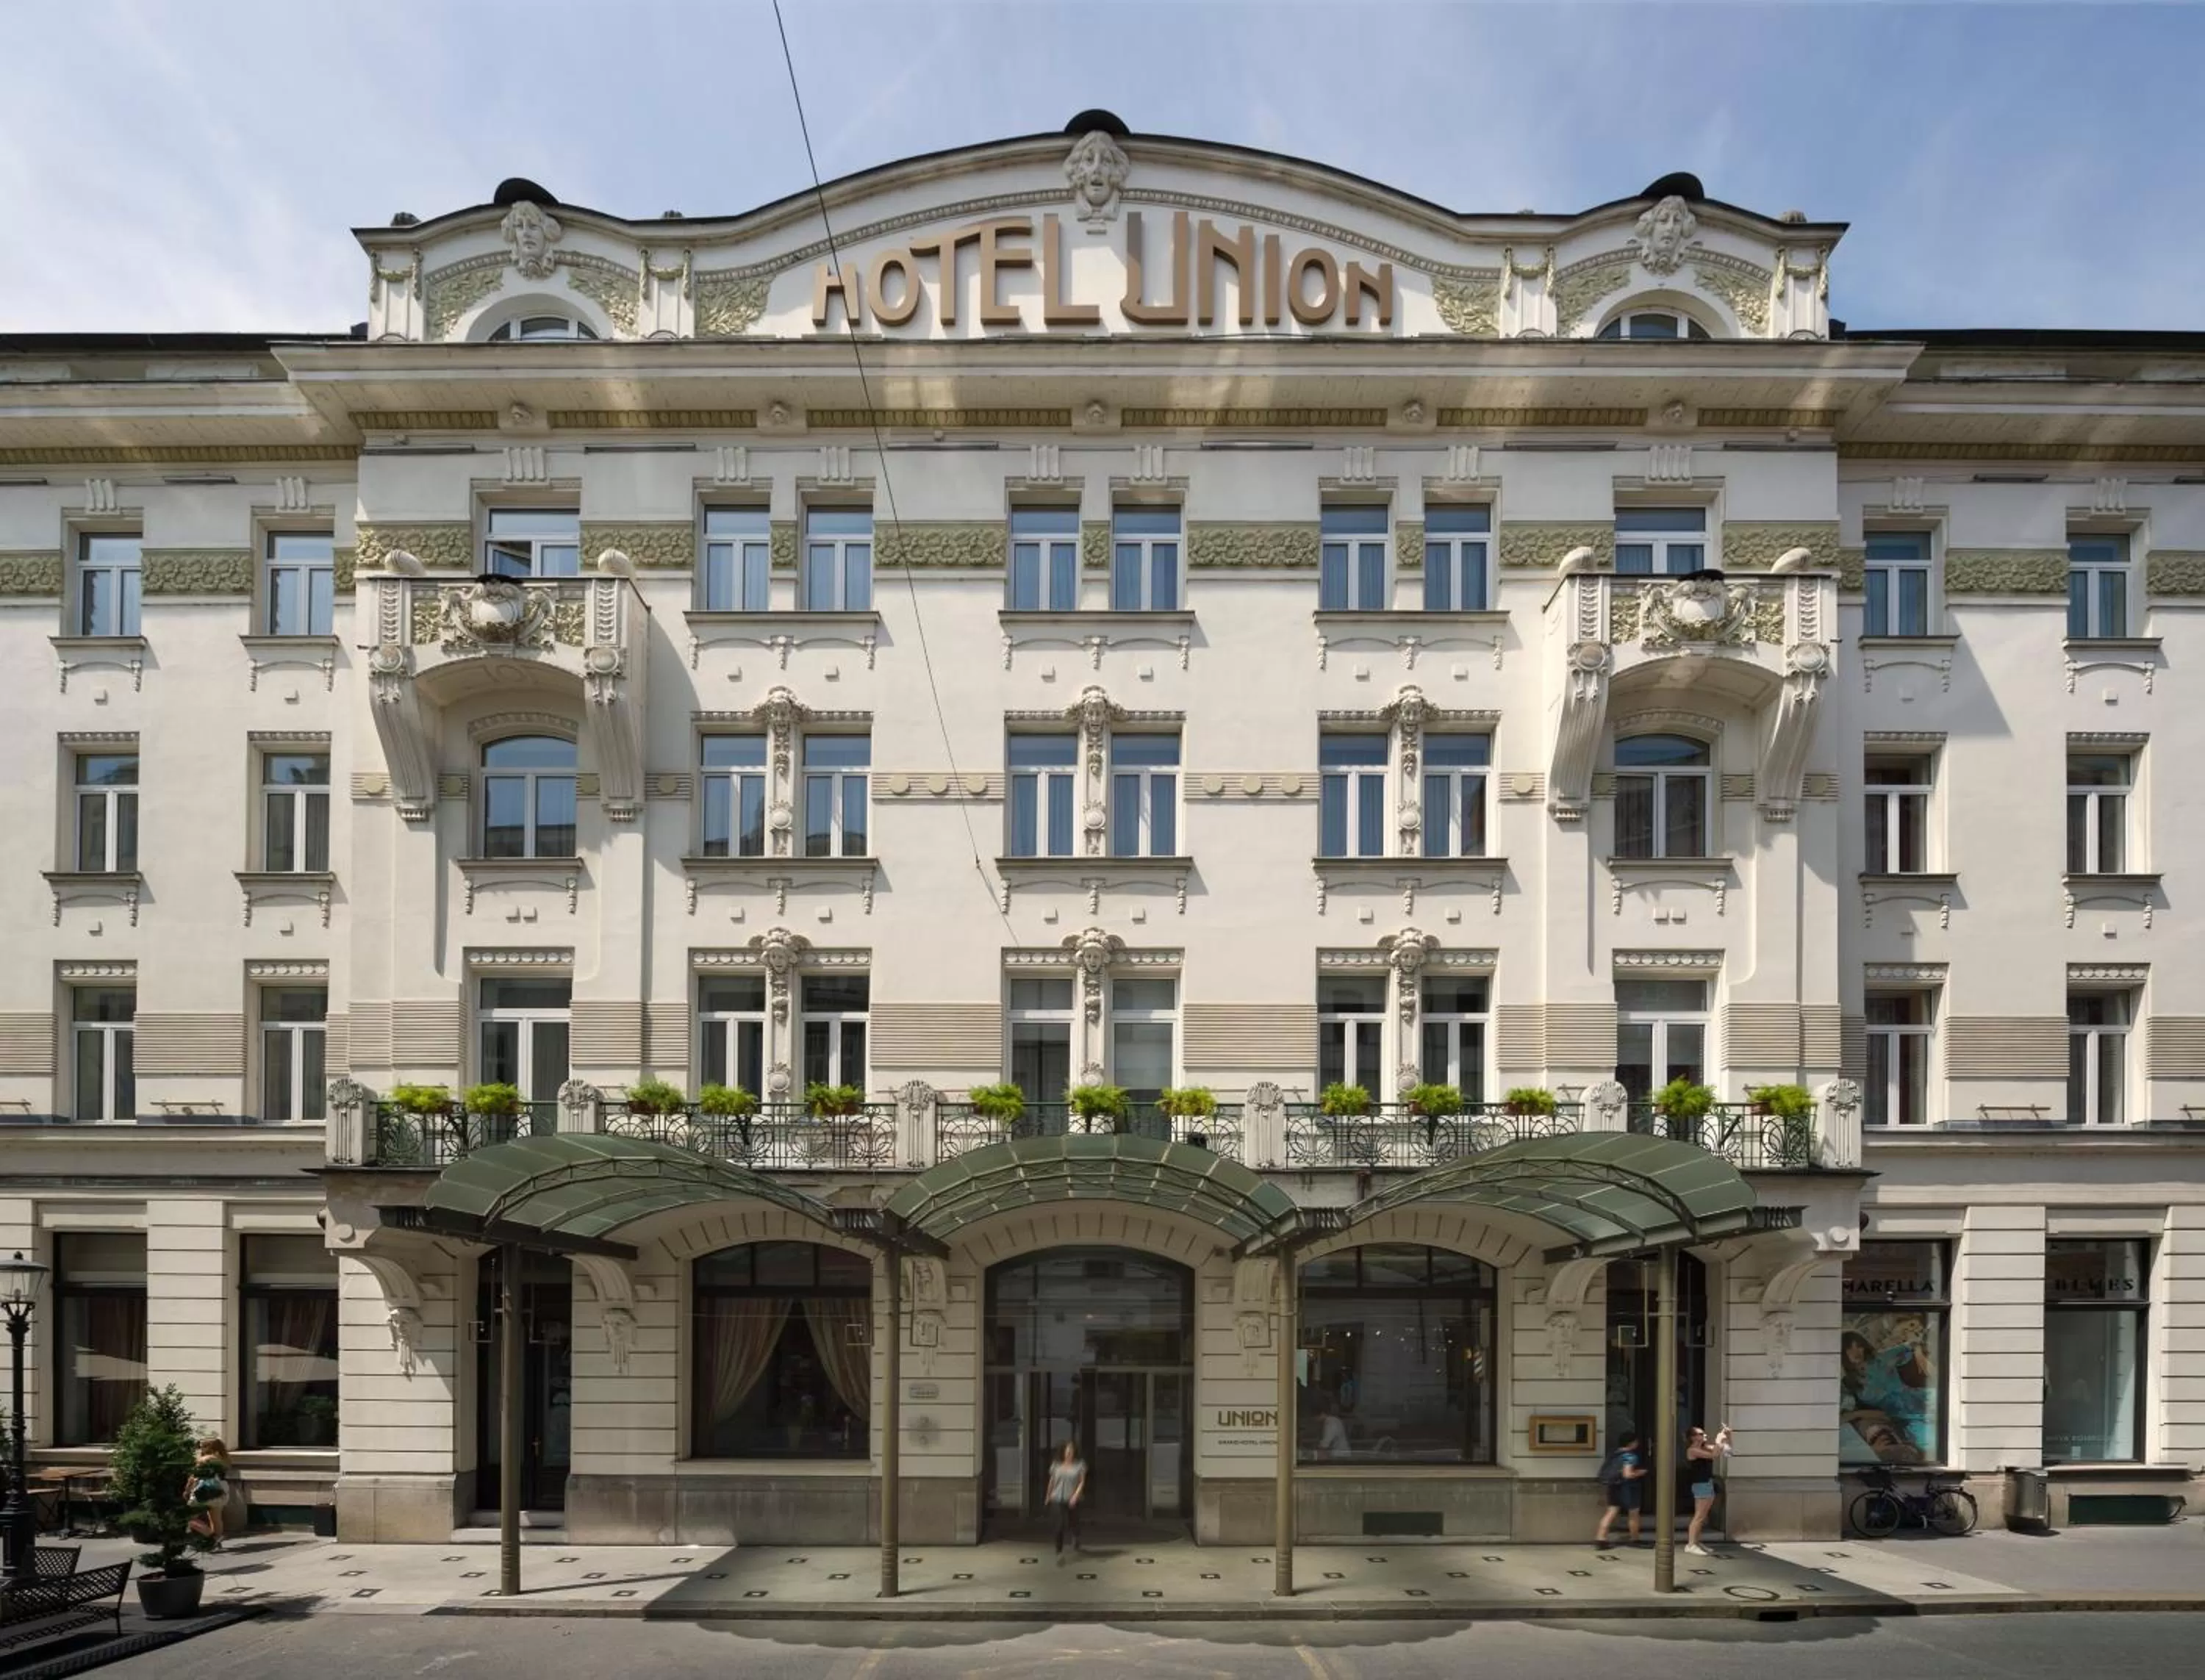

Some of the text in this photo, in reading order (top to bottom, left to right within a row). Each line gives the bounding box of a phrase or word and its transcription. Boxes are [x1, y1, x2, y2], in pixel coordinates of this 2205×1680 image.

[813, 211, 1393, 326] HOTEL UNION
[1842, 1279, 1934, 1292] MARELLA
[1218, 1410, 1278, 1426] UNION
